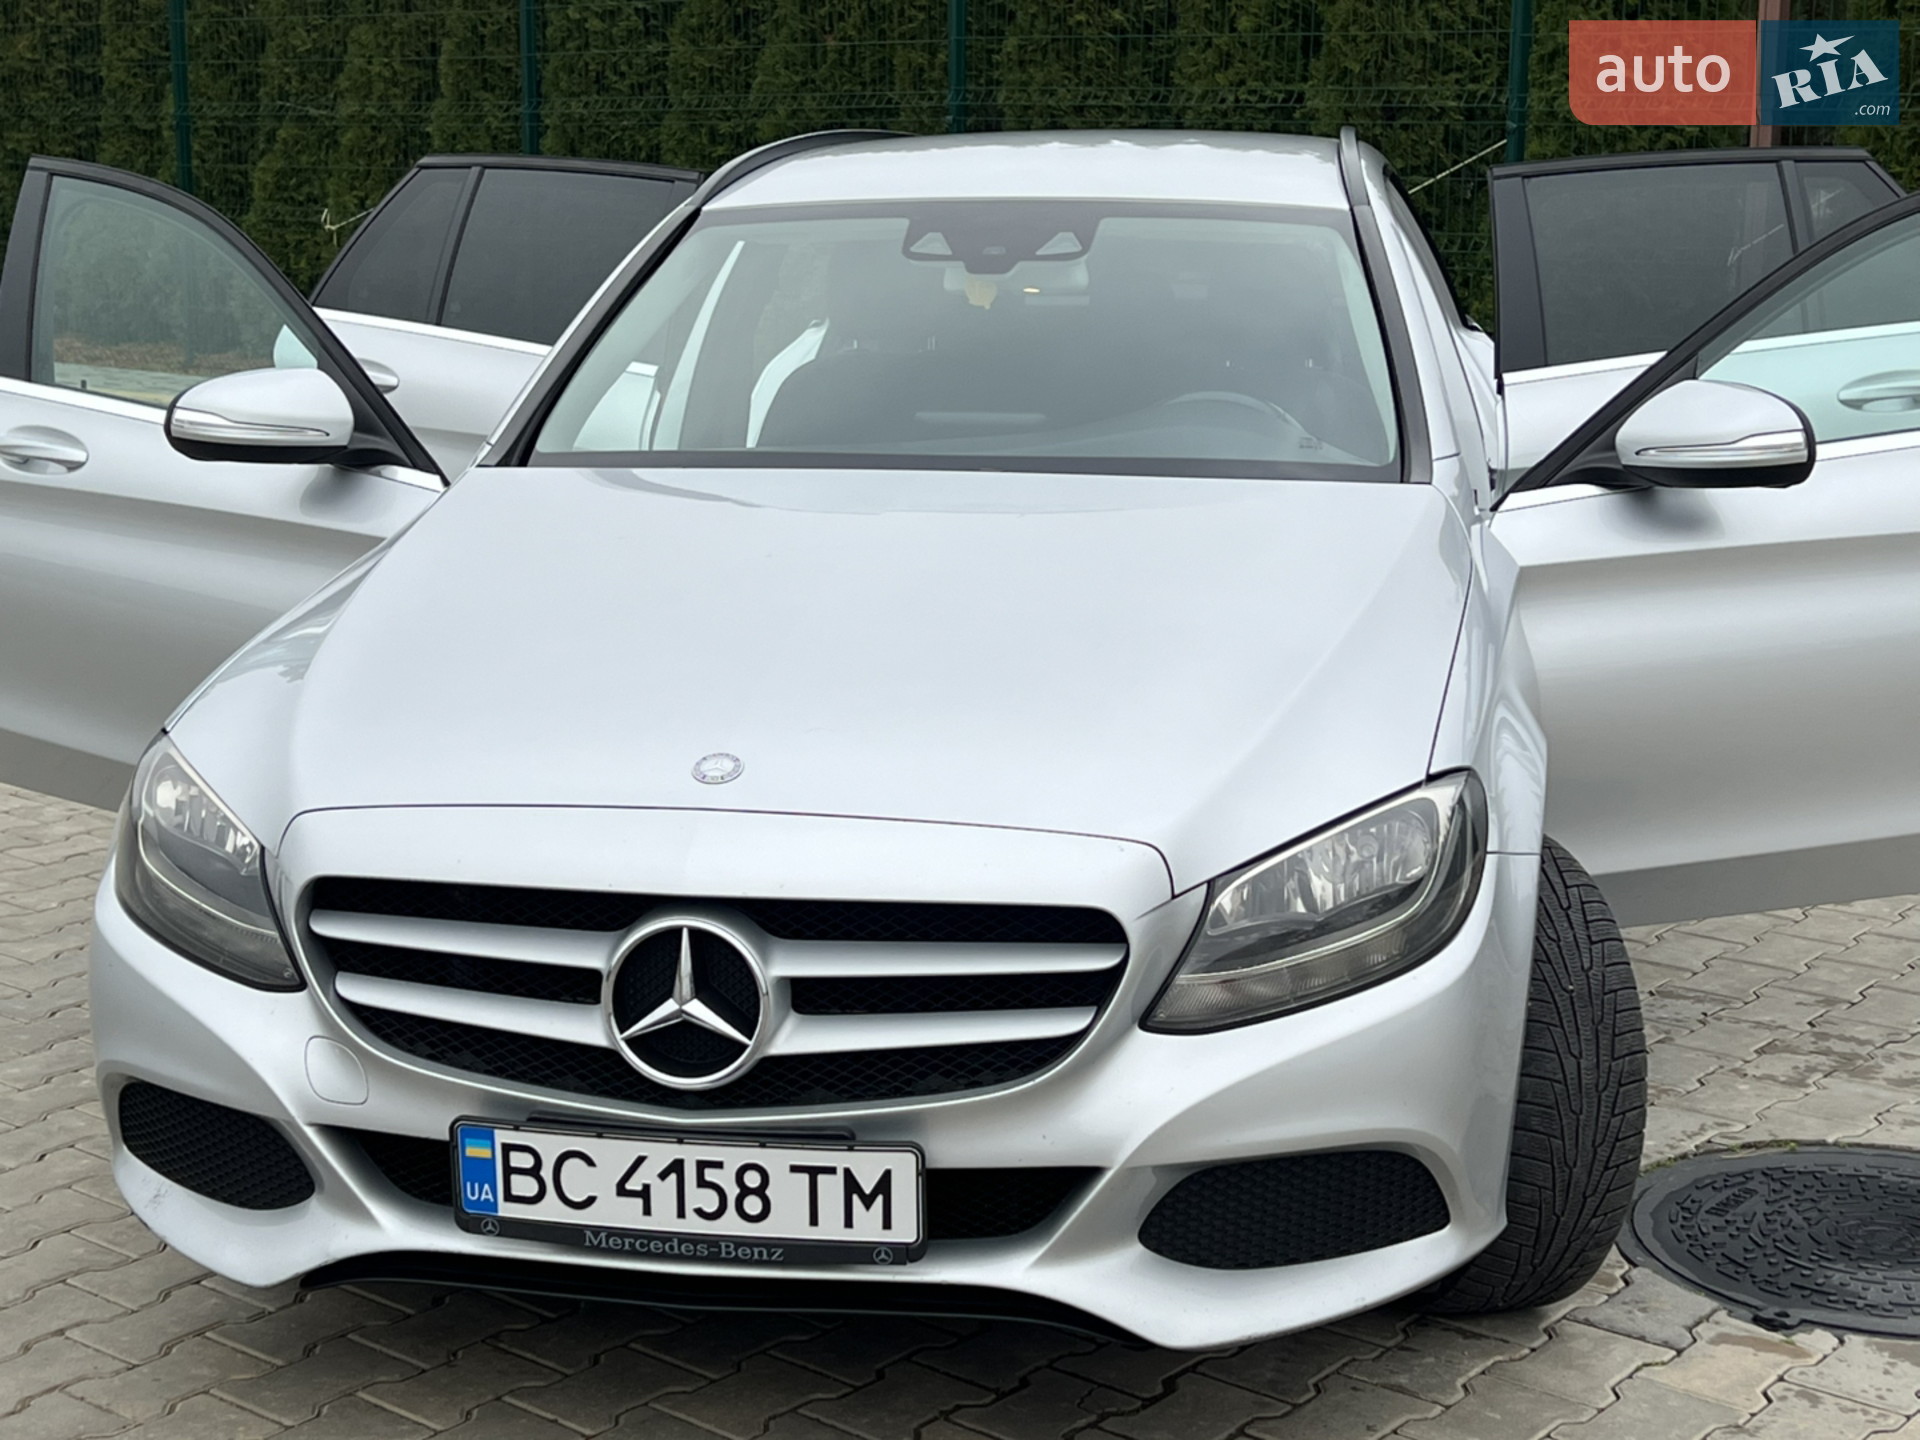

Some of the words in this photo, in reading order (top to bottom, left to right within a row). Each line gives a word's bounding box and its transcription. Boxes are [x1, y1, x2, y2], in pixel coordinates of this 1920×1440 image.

[466, 1182, 494, 1203] UA
[500, 1141, 598, 1210] BC
[615, 1155, 772, 1224] 4158
[789, 1164, 893, 1231] TM
[583, 1230, 784, 1261] Mercedes-Benz
